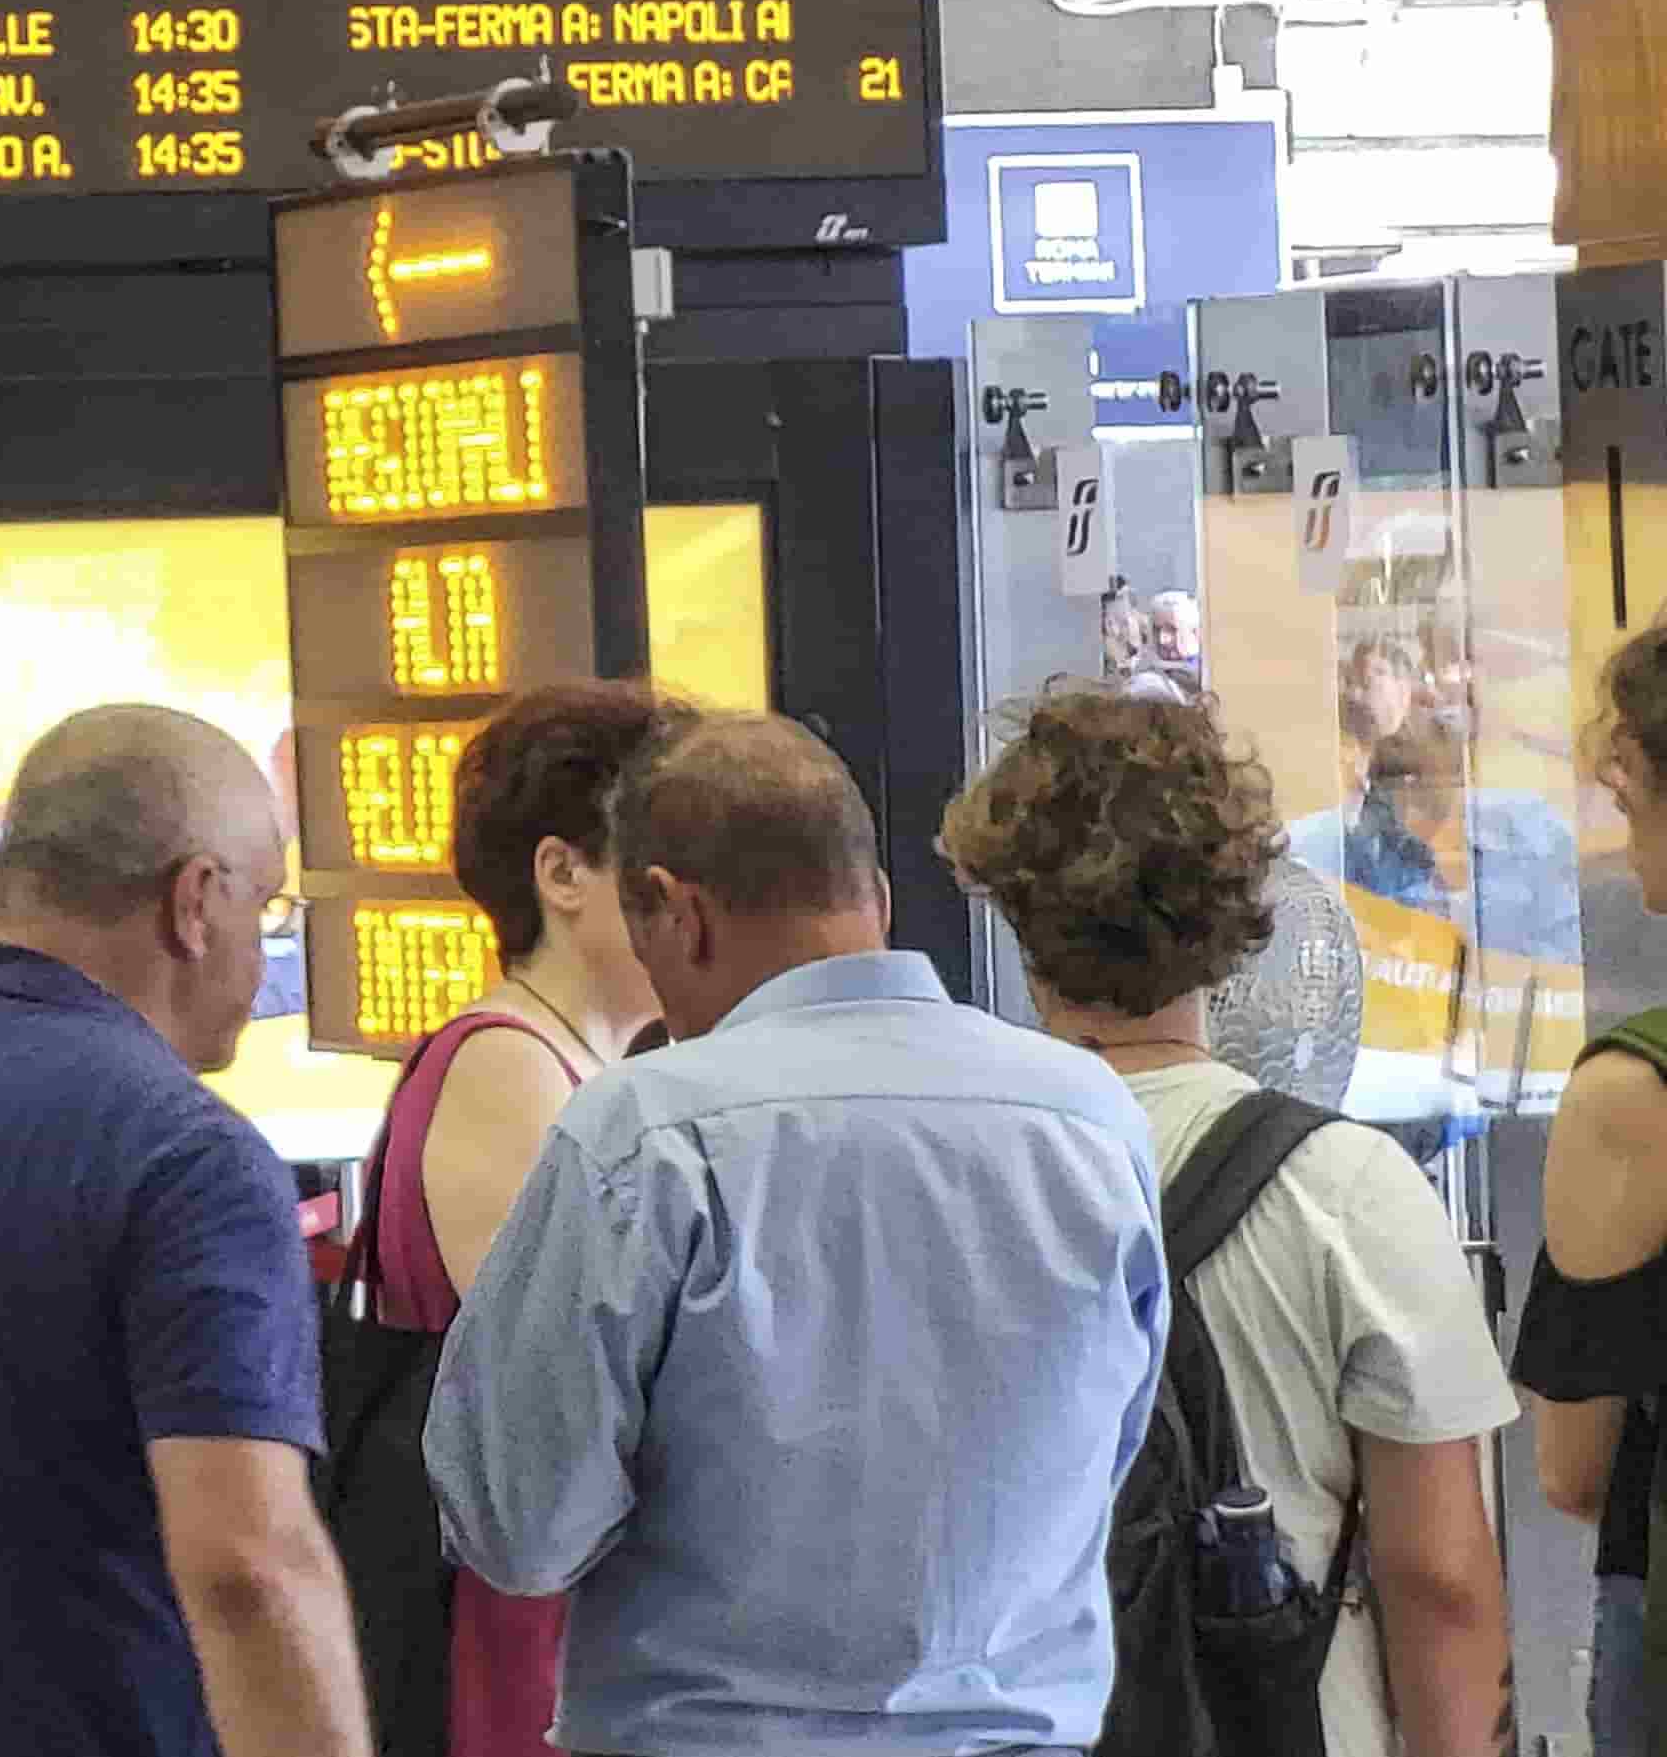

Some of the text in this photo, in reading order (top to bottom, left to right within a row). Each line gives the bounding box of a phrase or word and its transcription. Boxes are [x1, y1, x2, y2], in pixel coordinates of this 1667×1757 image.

[134, 10, 238, 52] 14:30
[614, 1, 743, 42] NAPOLI
[135, 71, 239, 113] 14:35
[861, 58, 898, 98] 21
[33, 136, 70, 176] A.
[137, 132, 241, 174] 14:35
[1570, 320, 1652, 392] GATE
